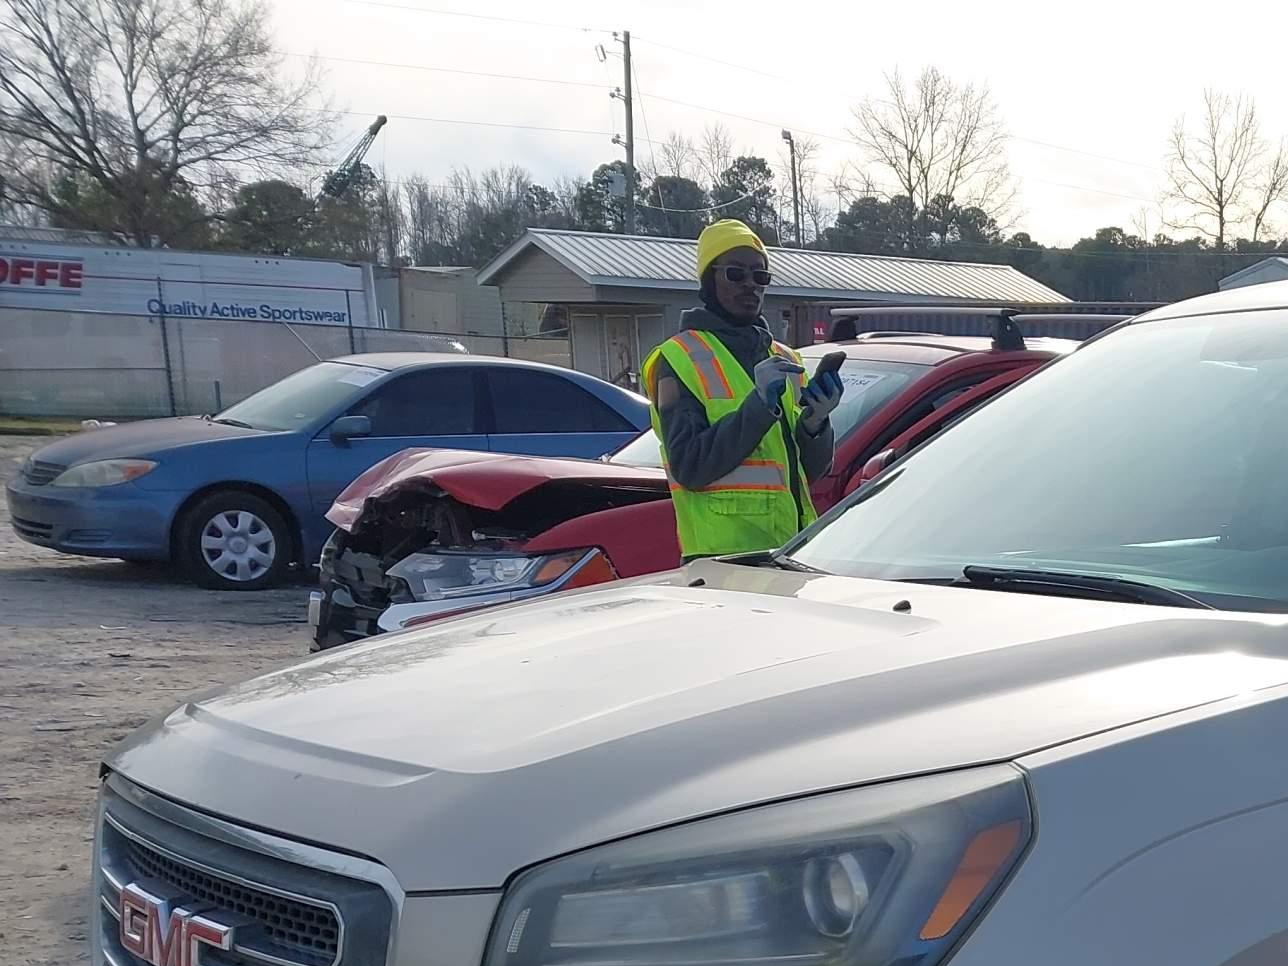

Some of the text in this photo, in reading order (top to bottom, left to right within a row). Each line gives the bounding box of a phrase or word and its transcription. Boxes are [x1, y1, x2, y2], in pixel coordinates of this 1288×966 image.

[147, 299, 347, 322] Quality Active Sportswear
